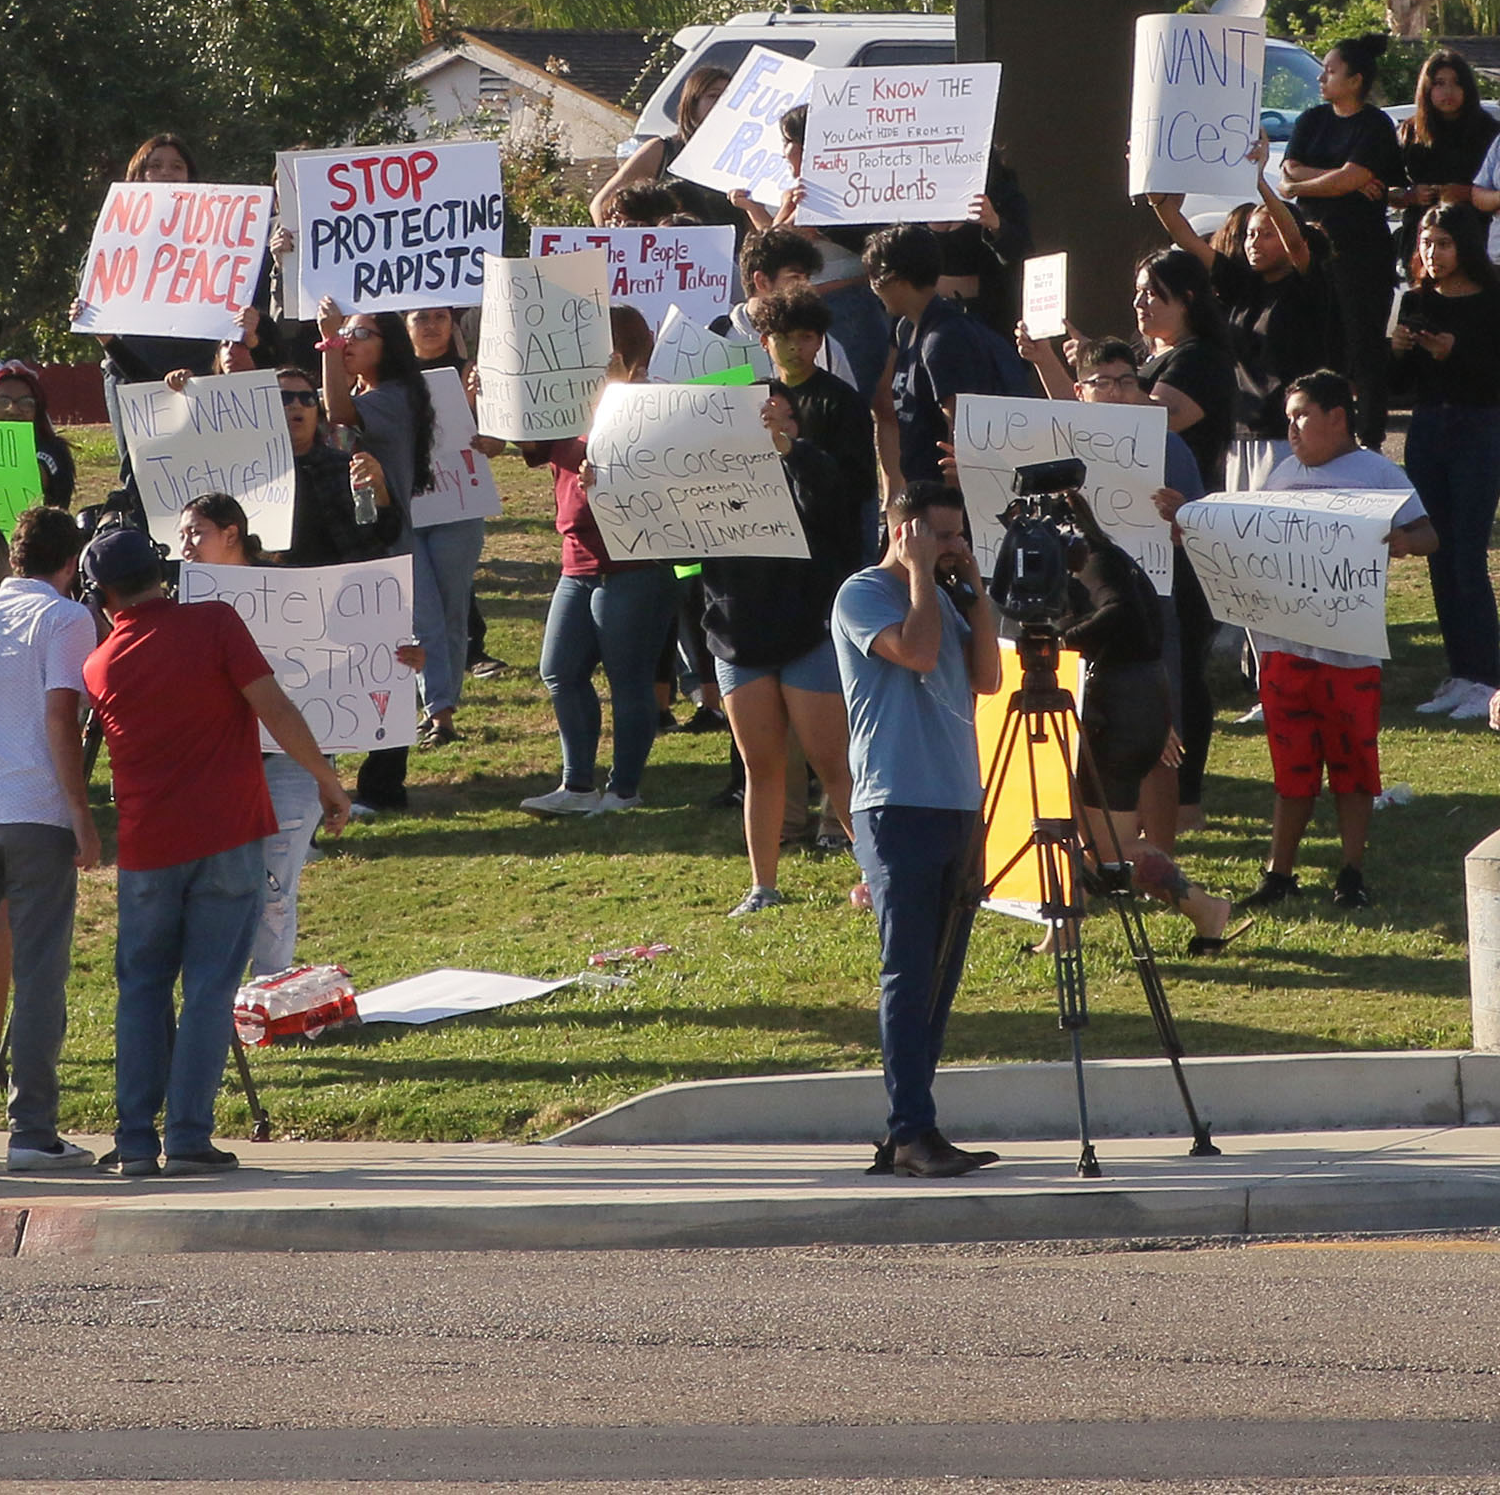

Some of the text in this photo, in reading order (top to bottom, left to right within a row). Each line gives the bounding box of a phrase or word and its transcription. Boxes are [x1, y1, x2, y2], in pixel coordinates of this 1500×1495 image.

[1146, 28, 1260, 88] WANT
[822, 77, 973, 106] WE KNOW THE
[823, 129, 845, 145] YOU
[877, 126, 900, 138] HIDE
[907, 126, 939, 138] FROM
[946, 125, 966, 136] IT!
[867, 107, 917, 126] TRUTH
[919, 146, 941, 165] The
[327, 150, 439, 212] STOP
[843, 168, 937, 208] Students
[103, 191, 153, 238] NO
[311, 193, 502, 271] PROTECTING
[353, 245, 485, 302] RAPISTS
[639, 234, 690, 271] People
[86, 242, 252, 311] NO PEACE
[611, 262, 728, 303] Aren't Taking
[120, 385, 281, 437] WE WANT
[1051, 416, 1149, 469] Need
